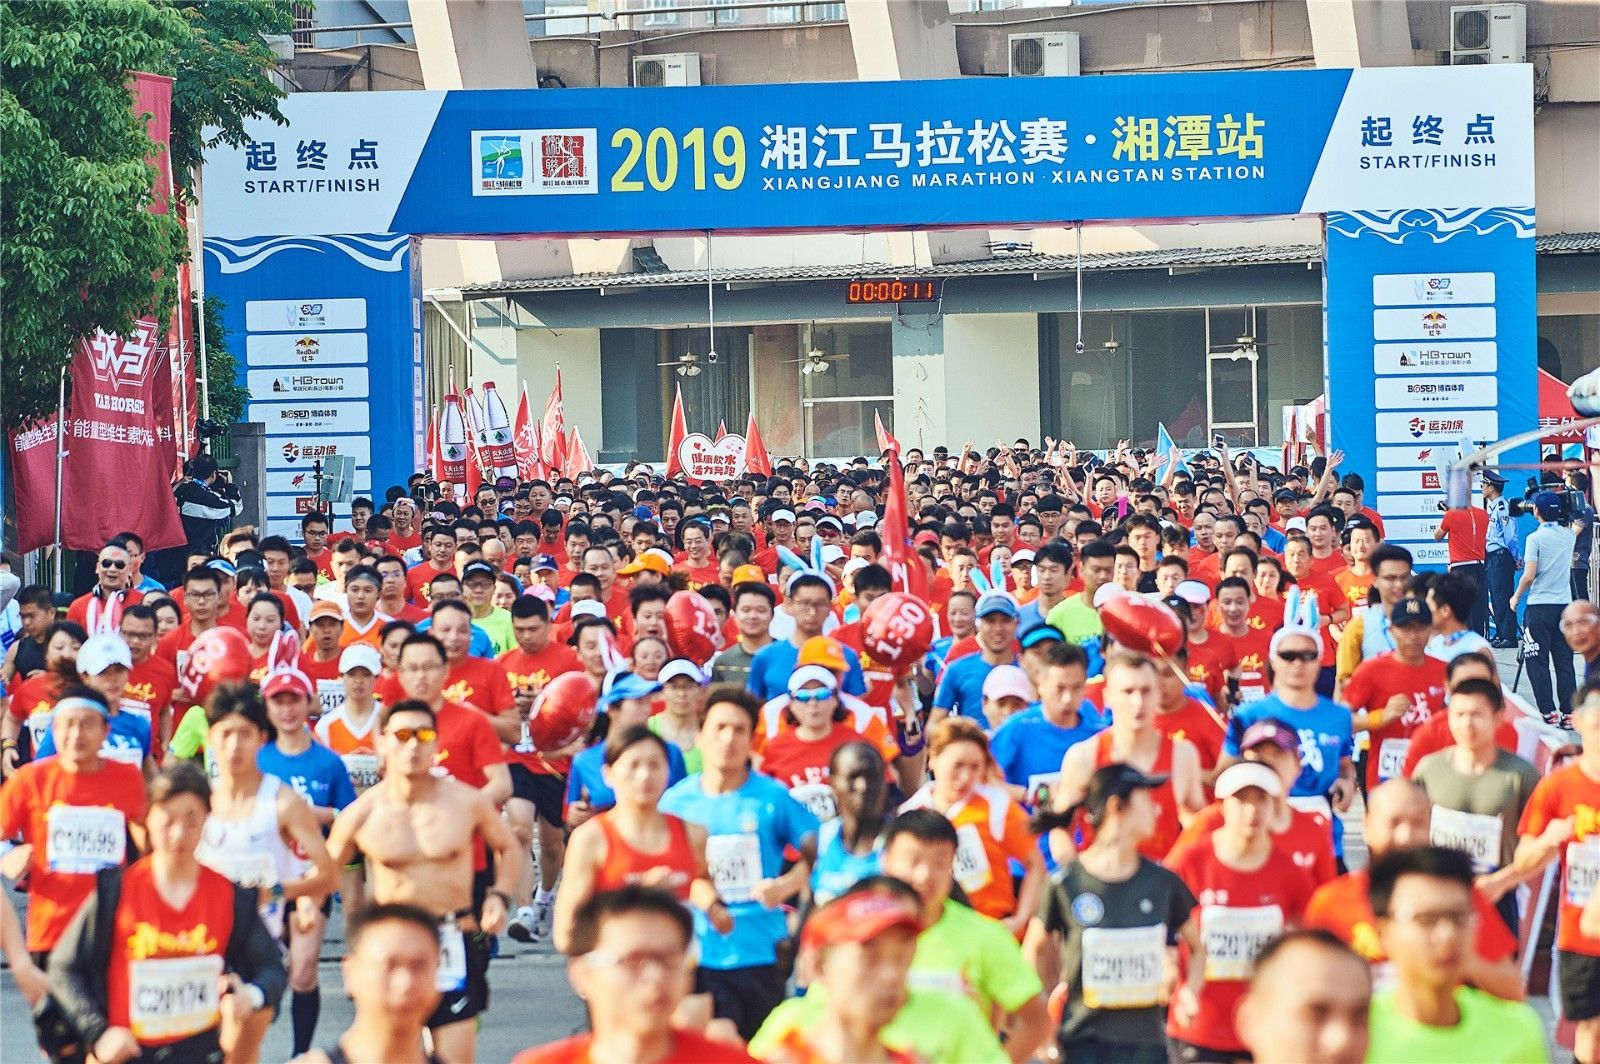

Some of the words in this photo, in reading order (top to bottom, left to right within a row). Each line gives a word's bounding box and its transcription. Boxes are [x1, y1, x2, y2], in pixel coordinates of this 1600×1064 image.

[1360, 113, 1496, 148] 起终点
[245, 138, 380, 172] 起终点
[611, 125, 747, 193] 2019
[1359, 153, 1497, 170] START/FINISH
[244, 177, 381, 194] START/FINISH
[761, 173, 901, 191] XIANGJIANG
[911, 170, 1036, 188] MARATHON
[1050, 166, 1165, 184] XIANGTAN
[1171, 164, 1266, 182] STATION
[850, 282, 934, 301] 00:00:11
[1428, 419, 1464, 431] 运动保
[302, 445, 337, 456] 运动保
[692, 464, 735, 476] 活力奔跑
[876, 602, 926, 661] 1:30
